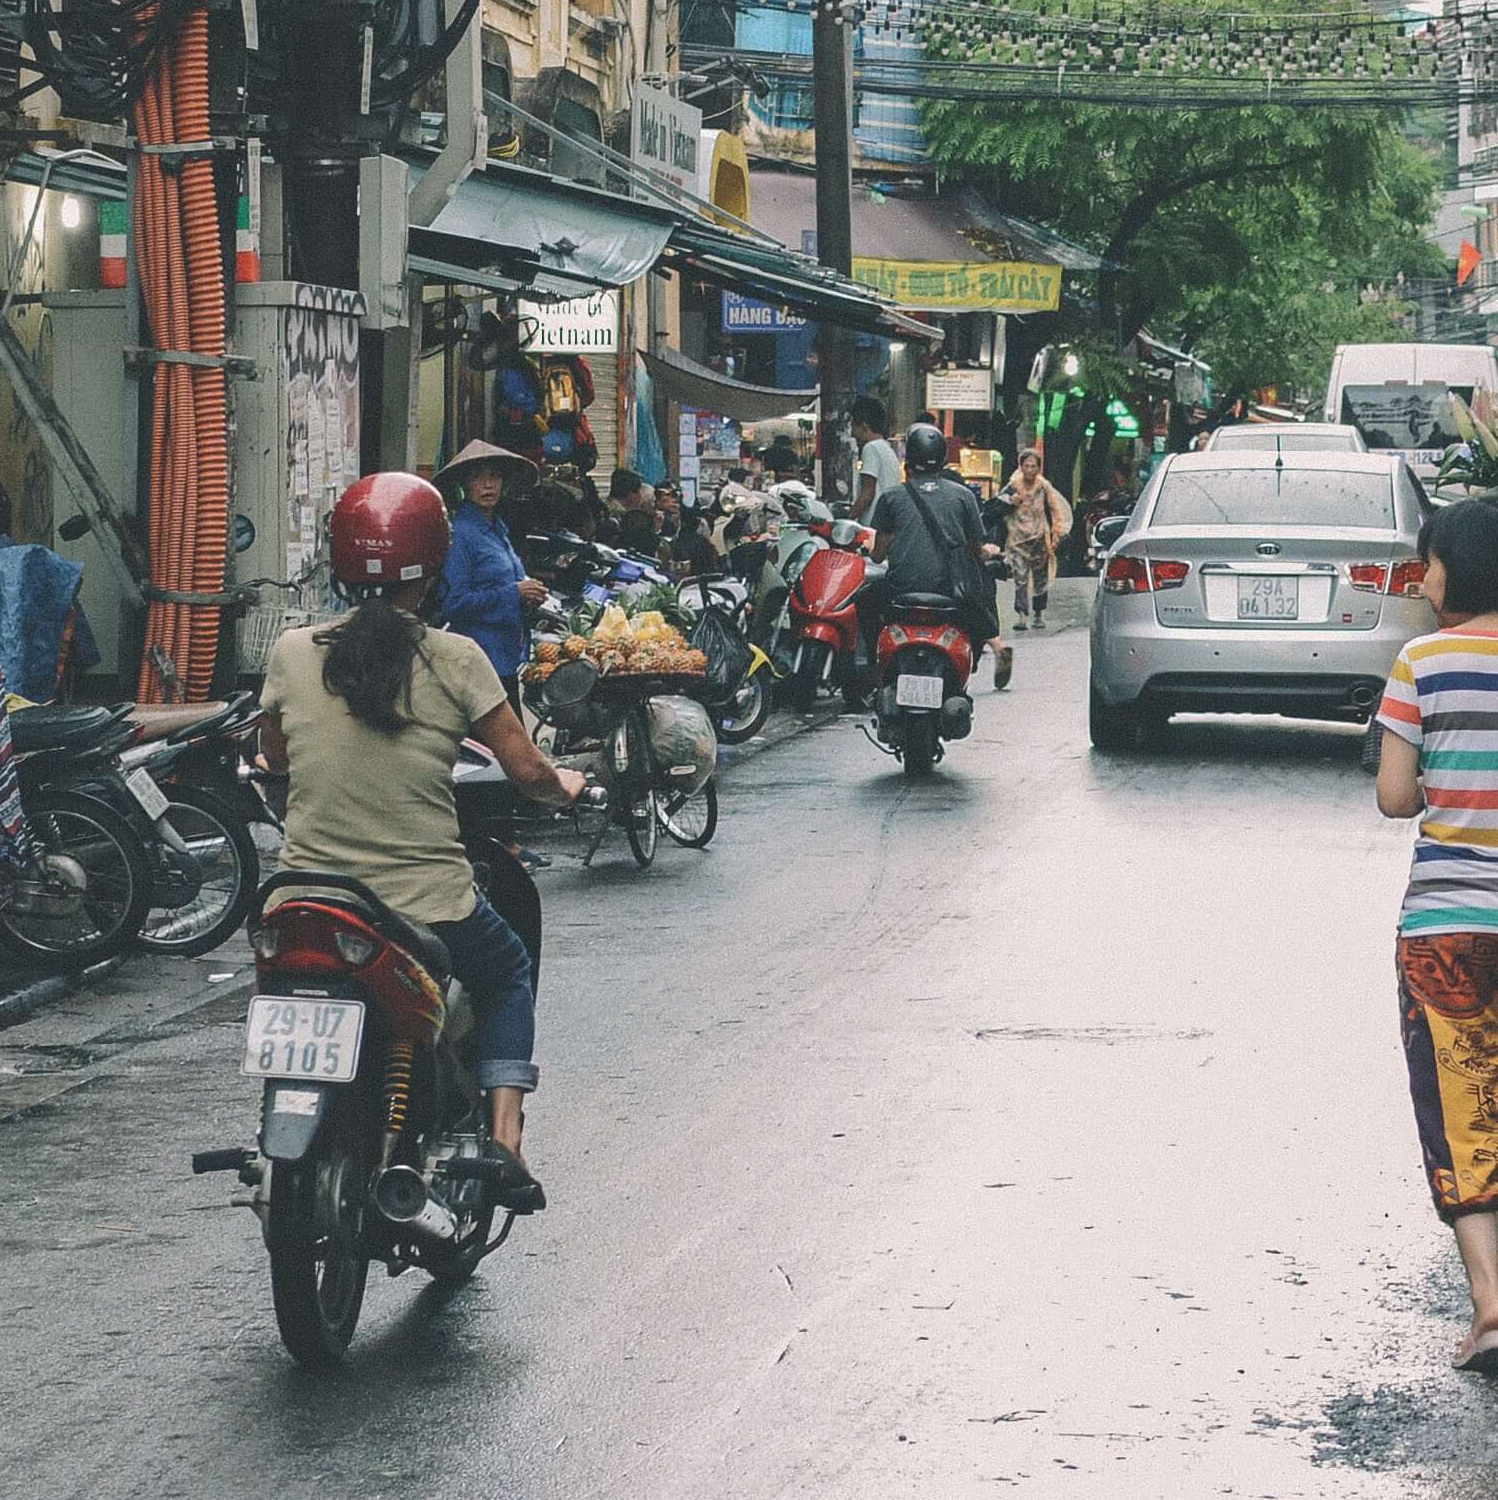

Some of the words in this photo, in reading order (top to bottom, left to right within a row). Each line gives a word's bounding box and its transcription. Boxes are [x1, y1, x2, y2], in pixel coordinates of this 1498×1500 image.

[729, 303, 772, 325] HÀNG
[520, 321, 613, 347] Vietnam
[1252, 578, 1283, 597] 29A
[1240, 598, 1296, 618] 041.32
[262, 1003, 346, 1038] 29-U7
[258, 1040, 341, 1075] 8105
